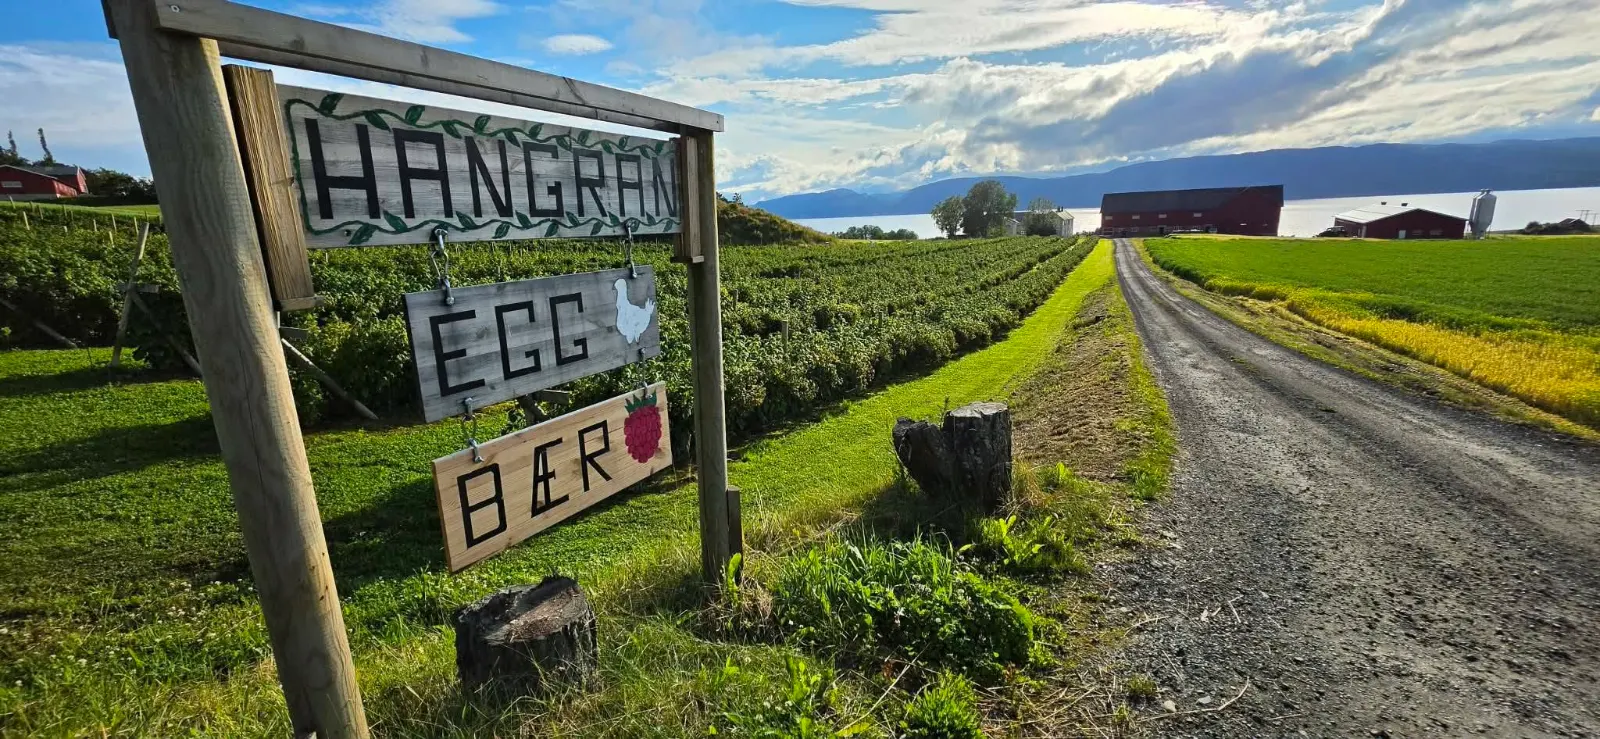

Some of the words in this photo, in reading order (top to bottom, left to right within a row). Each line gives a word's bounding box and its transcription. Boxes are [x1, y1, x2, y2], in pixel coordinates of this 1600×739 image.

[305, 118, 676, 219] HANGRAN
[429, 292, 588, 397] EGG
[457, 419, 613, 549] BÆR
